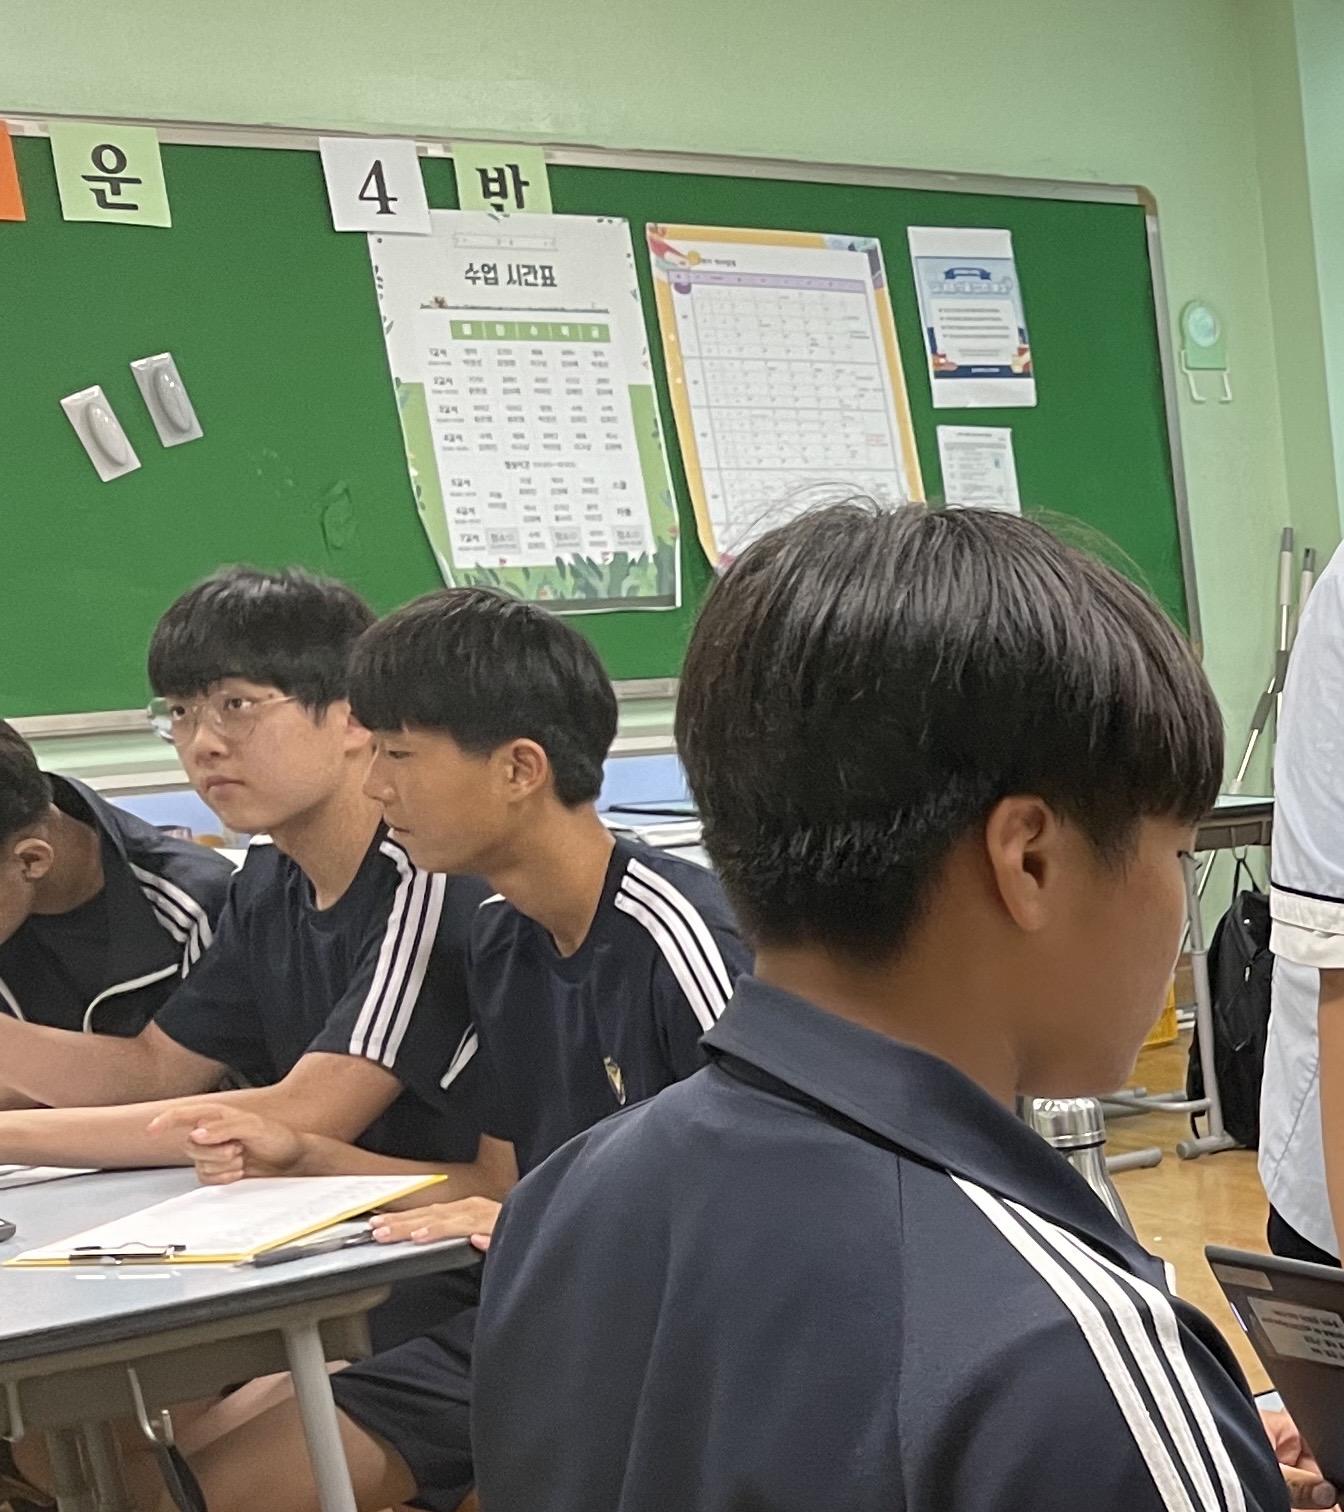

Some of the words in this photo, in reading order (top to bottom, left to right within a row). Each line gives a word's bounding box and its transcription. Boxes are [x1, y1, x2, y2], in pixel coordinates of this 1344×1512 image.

[81, 143, 143, 211] 운
[357, 159, 399, 215] 4
[476, 163, 530, 213] 반
[464, 263, 499, 286] 수업
[506, 264, 558, 288] 시간표
